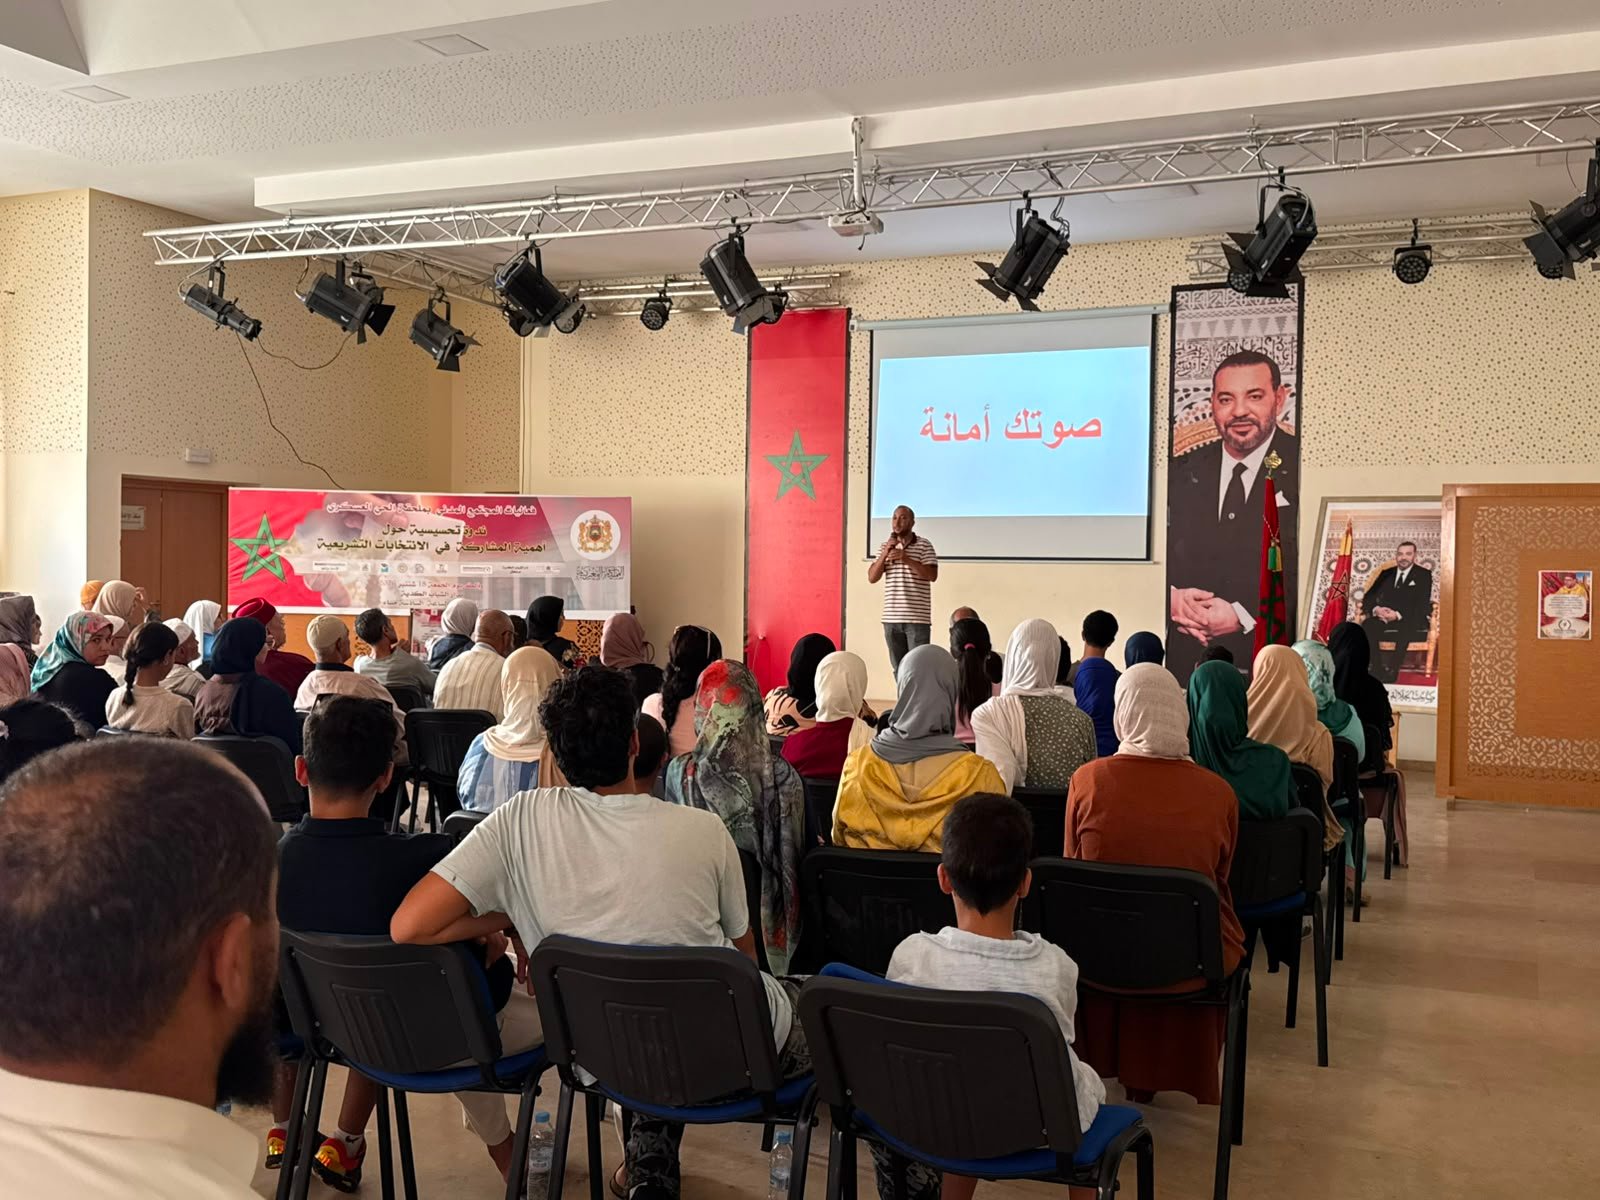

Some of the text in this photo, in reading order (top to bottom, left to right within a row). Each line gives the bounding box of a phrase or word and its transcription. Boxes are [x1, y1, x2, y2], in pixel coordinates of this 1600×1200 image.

[919, 404, 1102, 449] صوتك أمانة
[466, 504, 502, 518] المجتمع
[382, 524, 487, 538] ندوة تحسيسية حول
[317, 538, 372, 551] التشريعية
[375, 539, 430, 552] الانتخابات
[435, 541, 450, 555] في
[456, 541, 512, 554] المشاركة
